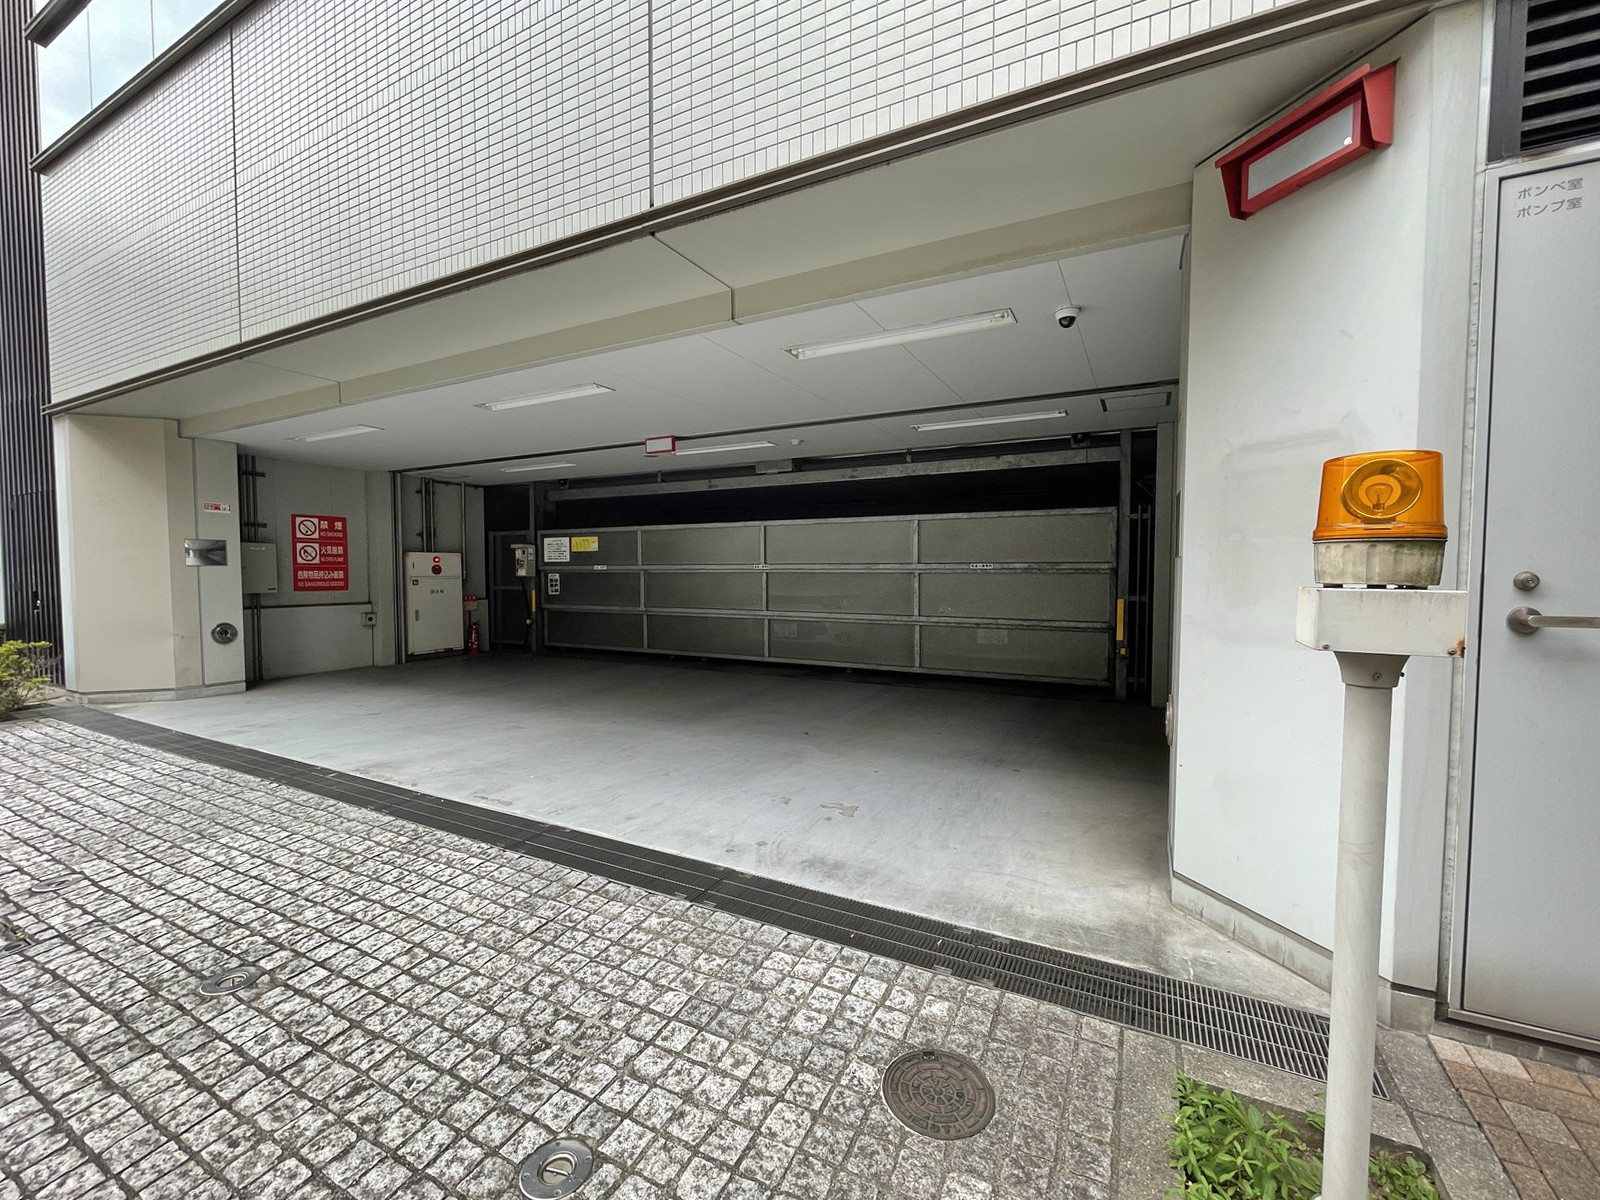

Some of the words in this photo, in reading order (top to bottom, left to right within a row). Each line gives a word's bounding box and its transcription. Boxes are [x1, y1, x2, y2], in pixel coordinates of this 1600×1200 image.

[1518, 178, 1583, 199] ボンベ室
[1517, 197, 1582, 218] ポンプ室
